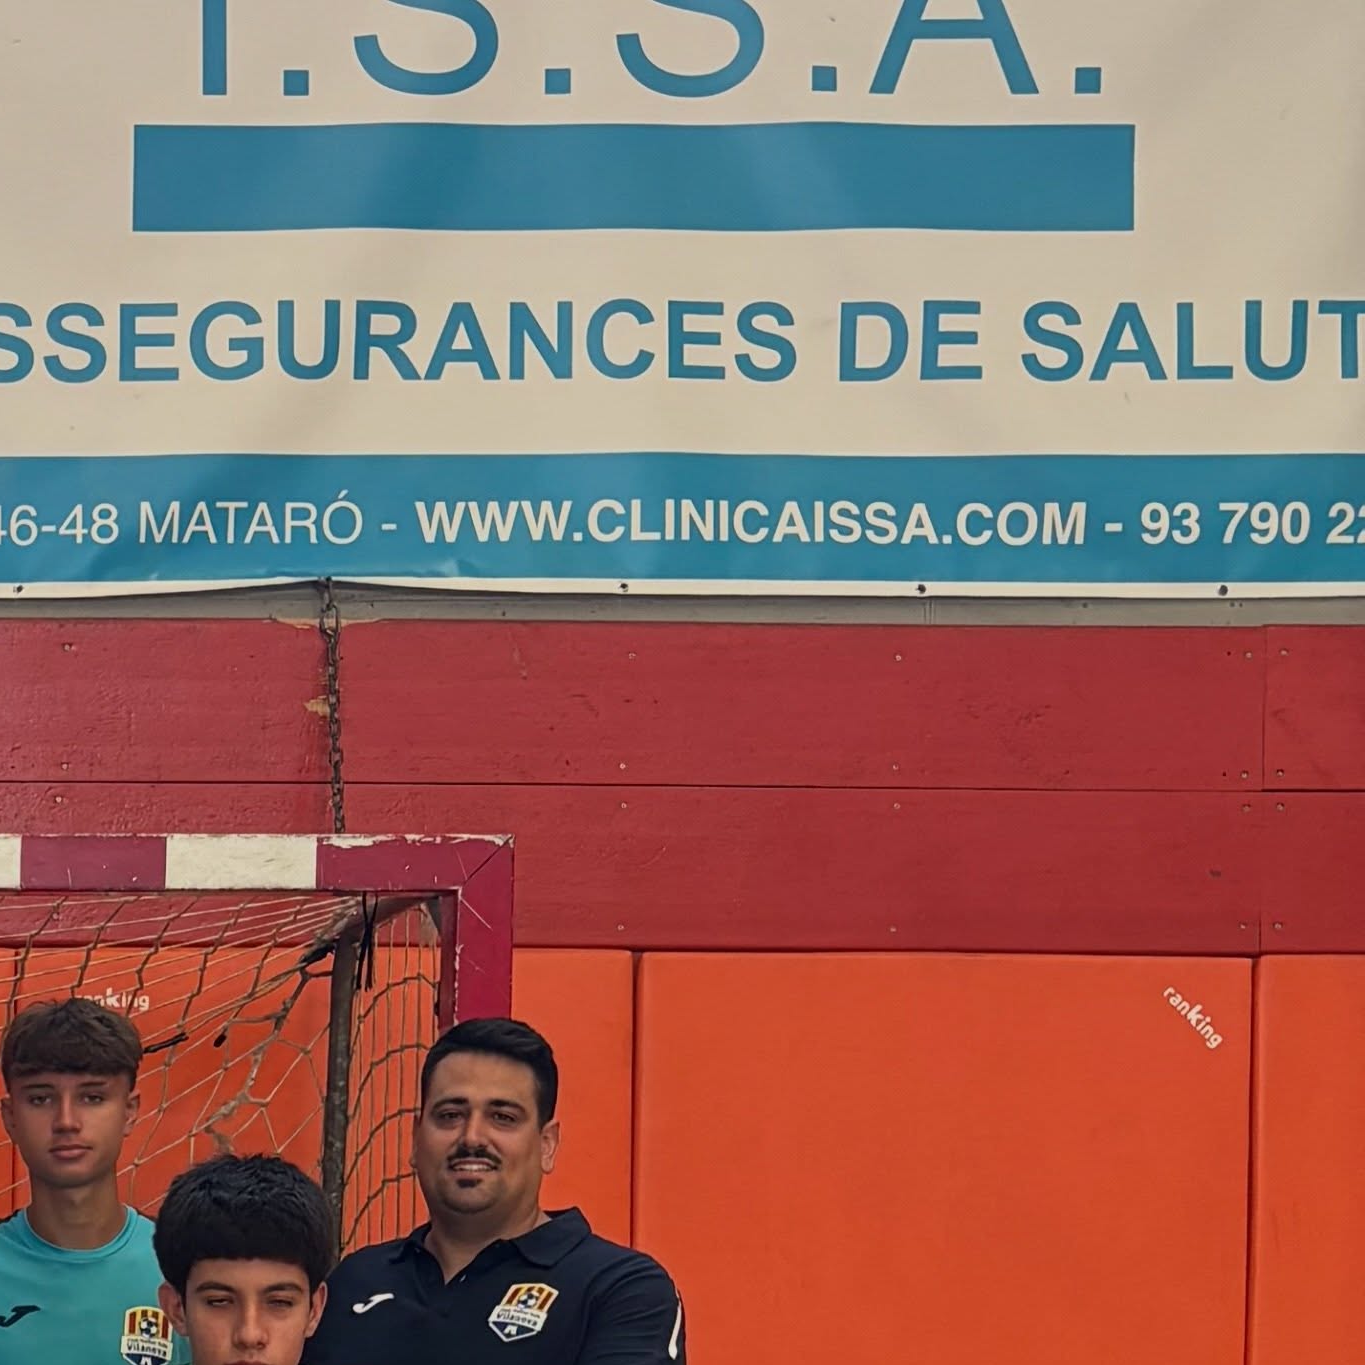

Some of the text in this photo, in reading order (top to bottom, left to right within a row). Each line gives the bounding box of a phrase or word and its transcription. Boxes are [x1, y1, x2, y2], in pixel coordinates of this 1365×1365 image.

[840, 300, 982, 381] DE
[1021, 300, 1365, 381] SALUT
[140, 490, 362, 544] MATARÓ
[415, 499, 1086, 545] WWW.CLINICAISSA.COM
[1141, 502, 1200, 544] 93
[1219, 502, 1310, 544] 790
[1326, 502, 1365, 543] 2
[1163, 987, 1223, 1049] ranking
